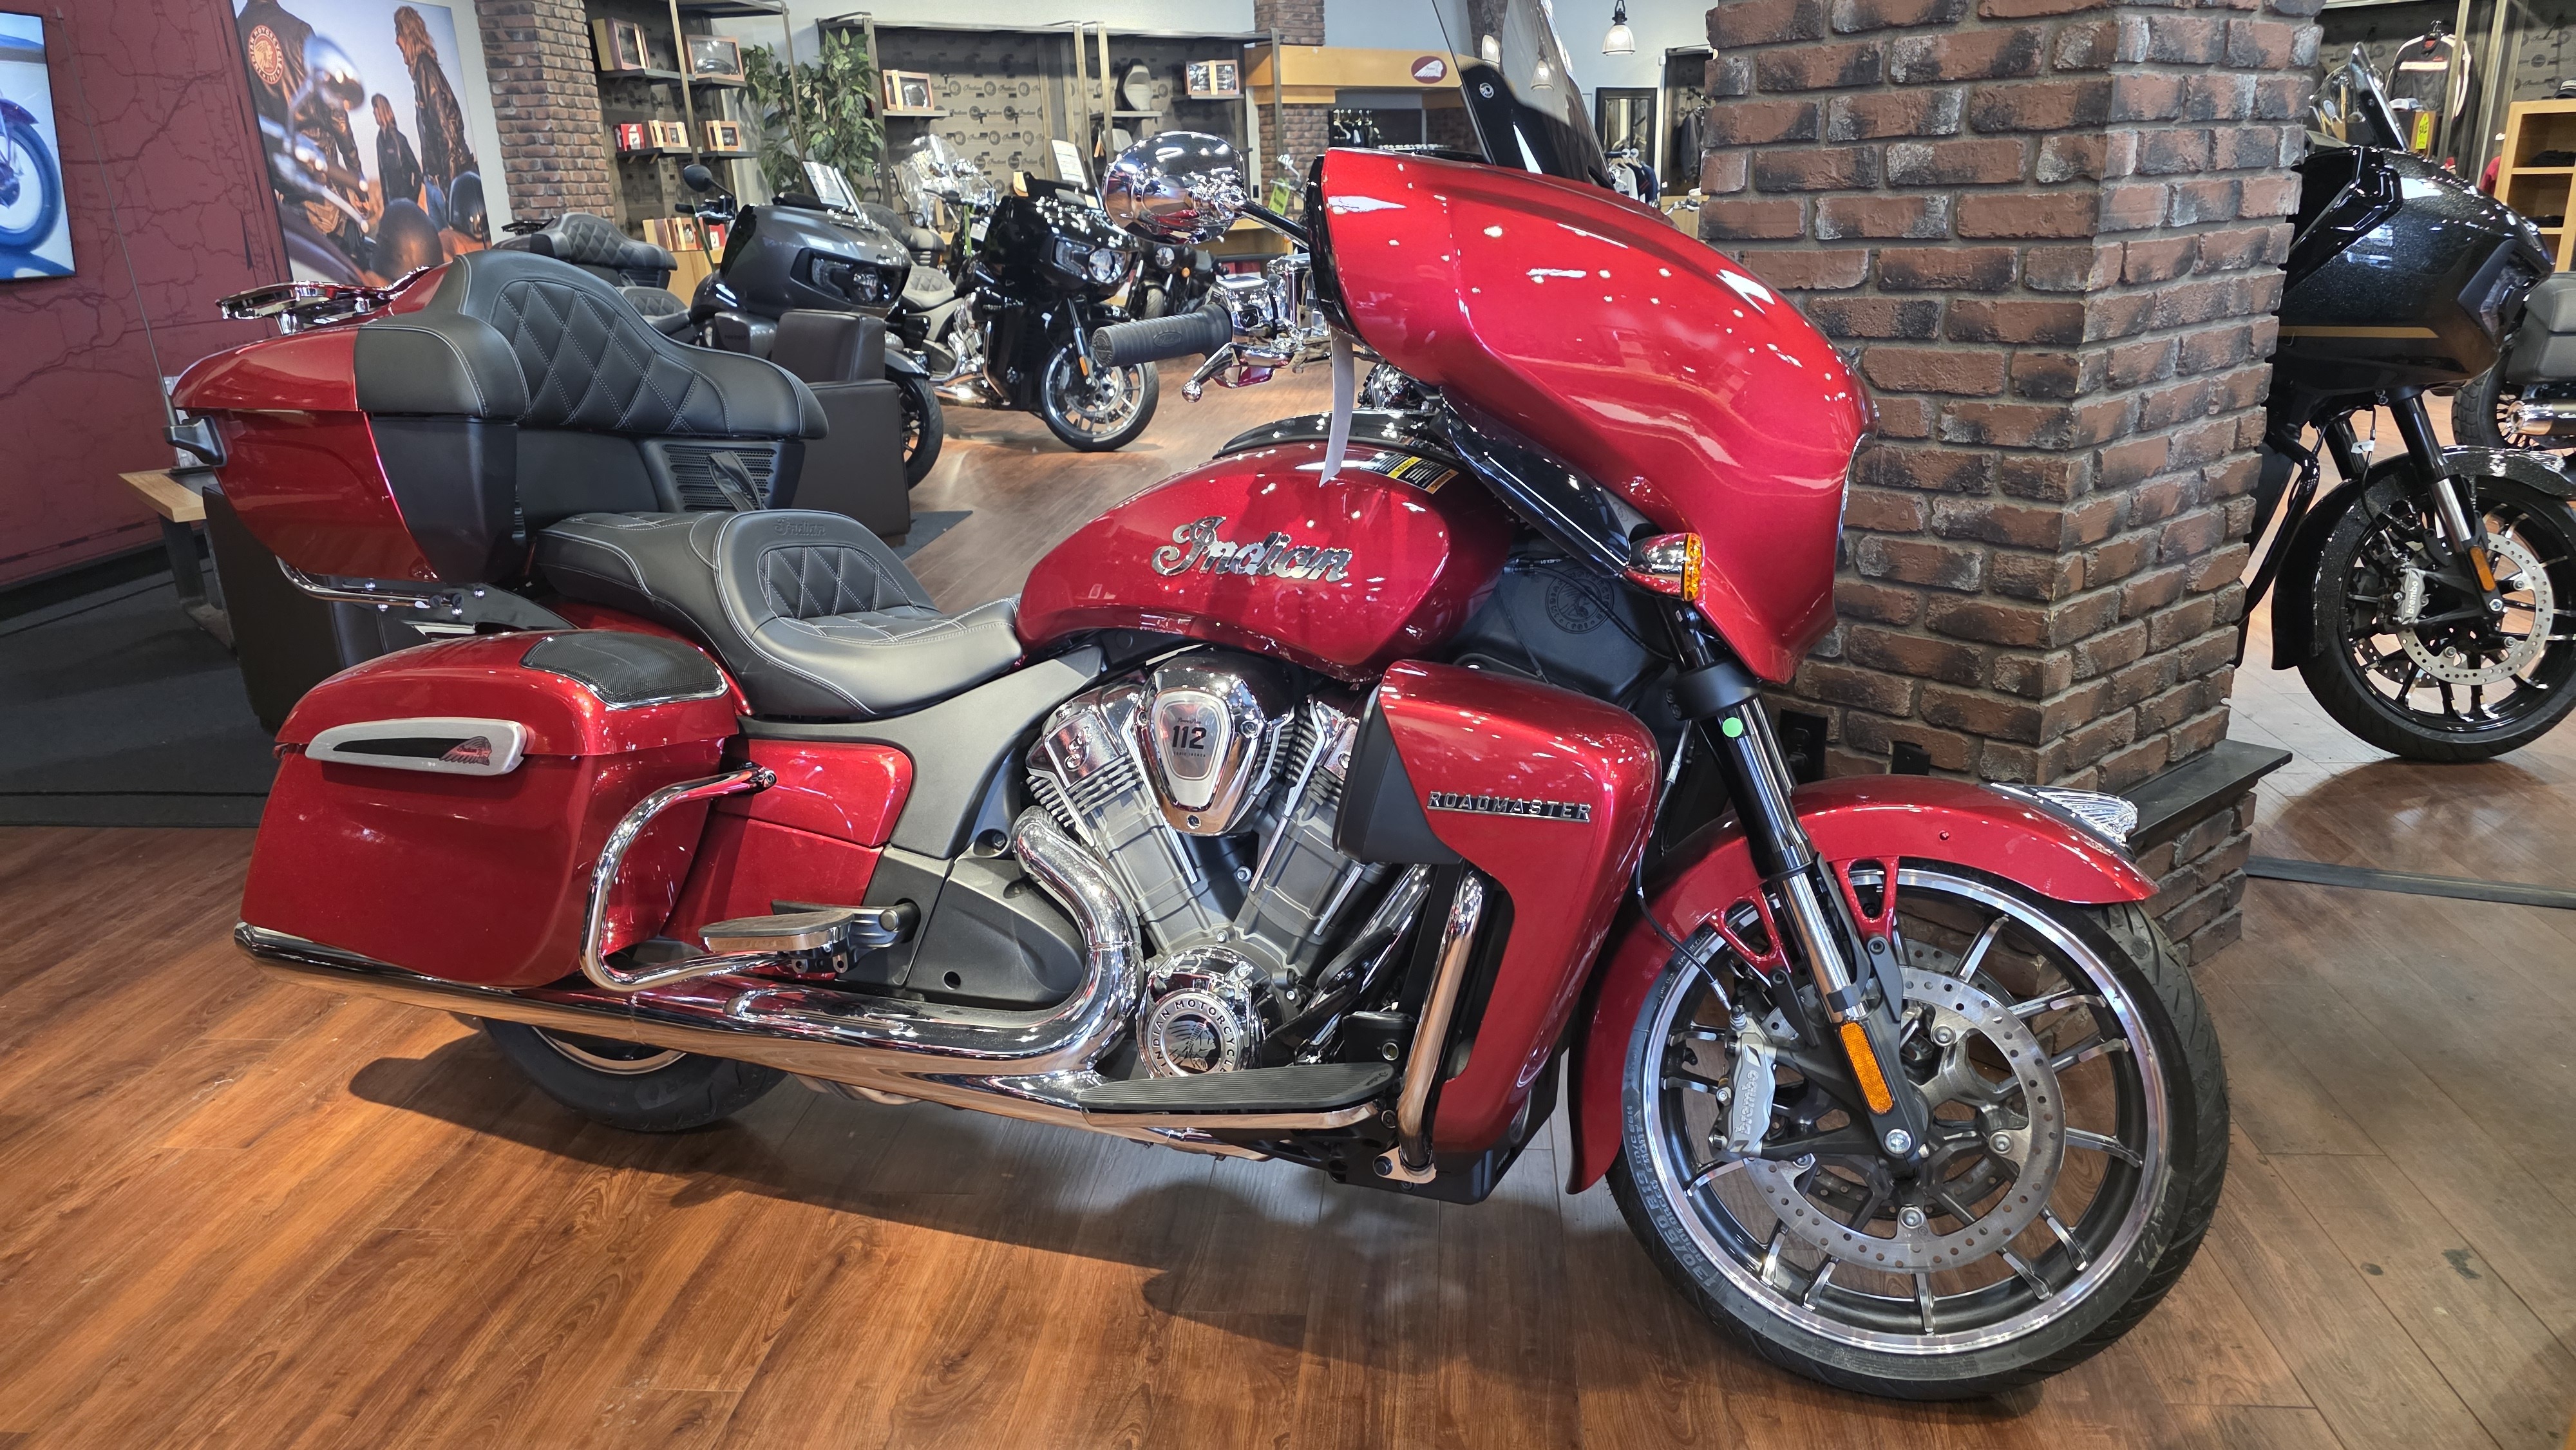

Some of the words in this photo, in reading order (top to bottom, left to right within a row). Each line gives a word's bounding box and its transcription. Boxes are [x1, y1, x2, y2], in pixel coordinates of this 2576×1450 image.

[1151, 516, 1353, 582] Indian
[2405, 581, 2418, 614] brembo
[1172, 725, 1208, 750] 112
[1427, 790, 1591, 821] ROADMASTER
[1152, 1008, 1170, 1068] INDIAN
[1734, 1069, 1759, 1135] brembo
